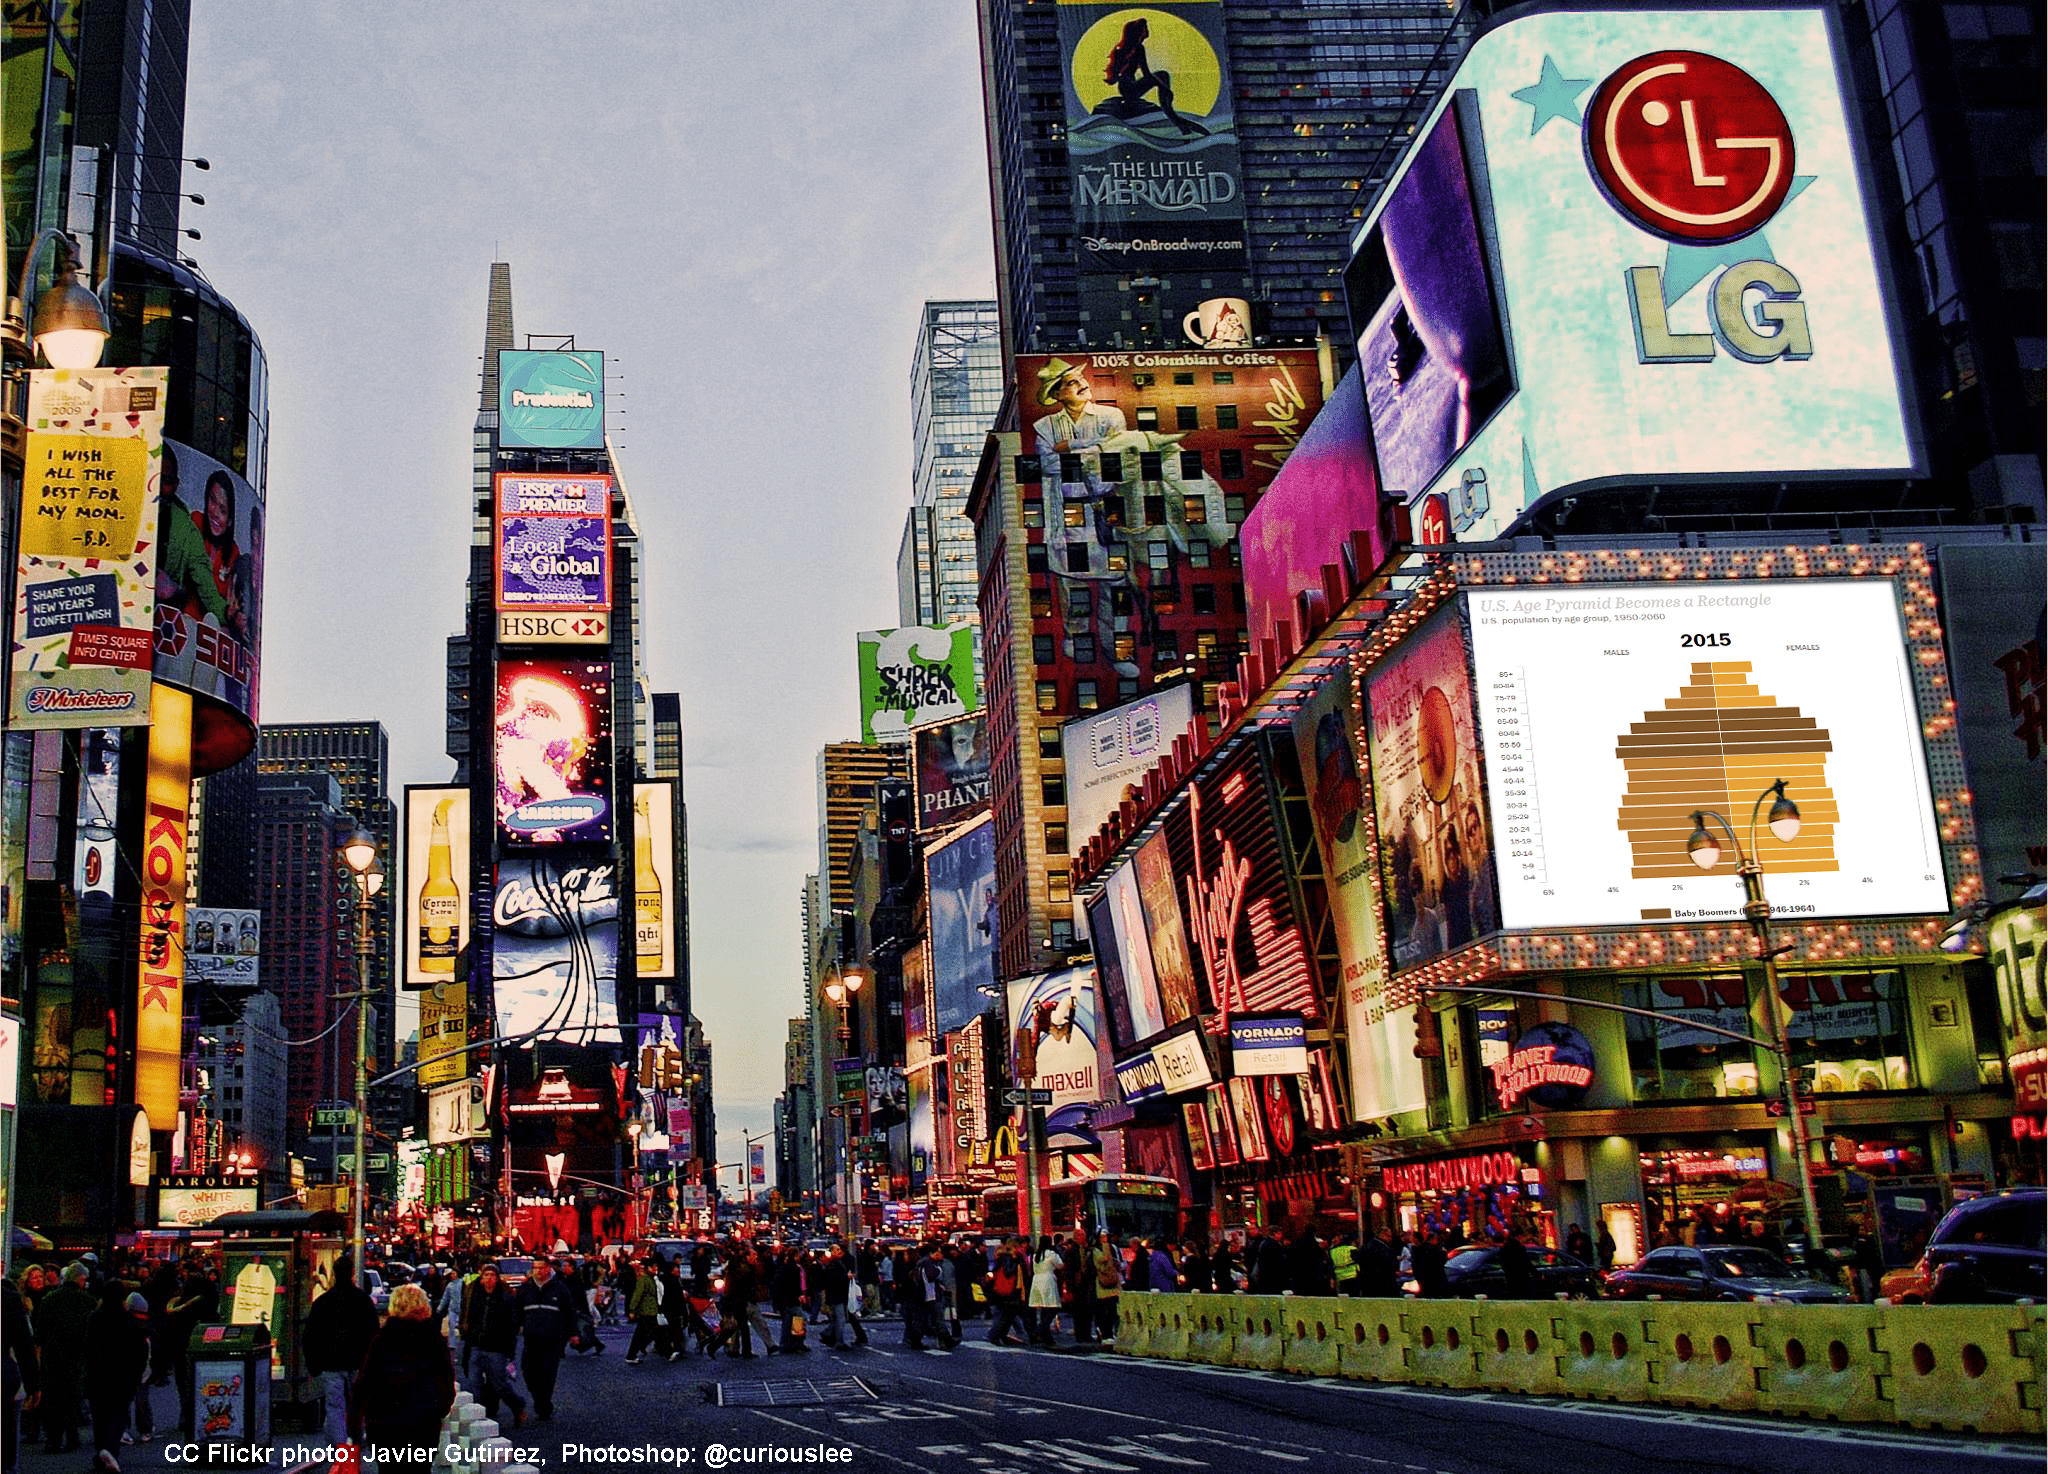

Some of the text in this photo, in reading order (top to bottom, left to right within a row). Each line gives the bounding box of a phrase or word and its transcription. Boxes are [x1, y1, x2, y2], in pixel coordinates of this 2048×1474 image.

[1109, 161, 1145, 177] THE
[1150, 161, 1205, 177] LITTLE
[1078, 172, 1236, 212] MERMAID
[1080, 236, 1243, 255] DisneyOnBroadway.com
[1625, 260, 1813, 364] LG
[1092, 351, 1276, 368] 100% Colombian Coffee
[52, 407, 81, 415] 2009
[48, 449, 101, 462] I WISH
[45, 467, 116, 480] ALL THE
[42, 485, 120, 501] BEST FOR
[518, 482, 562, 498] HSBC
[38, 505, 66, 520] MY
[519, 499, 588, 512] PREMIER
[508, 536, 565, 555] Local
[530, 556, 600, 576] Global
[32, 584, 95, 600] SHARE YOUR
[33, 603, 56, 614] NEW
[1481, 600, 1510, 612] U.S.
[1513, 599, 1542, 614] Age
[1545, 596, 1611, 613] Pyramid
[1615, 595, 1681, 609] Becomes
[1698, 592, 1772, 608] Rectangle
[33, 609, 112, 627] CONFETTI WISH
[1502, 615, 1550, 625] population
[1552, 616, 1562, 624] by
[1564, 616, 1581, 624] age
[501, 618, 567, 636] HSBC
[78, 633, 148, 649] TIMES SQUARE
[1680, 633, 1731, 648] 2015
[74, 647, 137, 661] INFO CENTER
[880, 663, 955, 696] SHREK
[45, 690, 133, 708] Musketeers
[884, 689, 956, 712] MUSICAL
[423, 899, 457, 910] Corona
[1674, 909, 1697, 918] Baby
[1699, 907, 1737, 917] Boomers
[1769, 904, 1816, 914] 946-1964)
[1232, 1026, 1305, 1039] VORNADO
[1162, 1044, 1200, 1081] Retail
[1253, 1051, 1286, 1063] Retail
[1490, 1045, 1557, 1091] PLANET
[1042, 1066, 1094, 1091] maxell
[1117, 1060, 1161, 1098] VORNADO
[1498, 1063, 1593, 1110] HOLLYWOOD
[953, 1043, 969, 1148] PALACE
[327, 1111, 337, 1122] 45
[1383, 1164, 1426, 1192] PLANET
[1428, 1152, 1517, 1190] HOLLYWOOD
[160, 1177, 259, 1187] MARQUIS
[192, 1191, 233, 1203] WHITE
